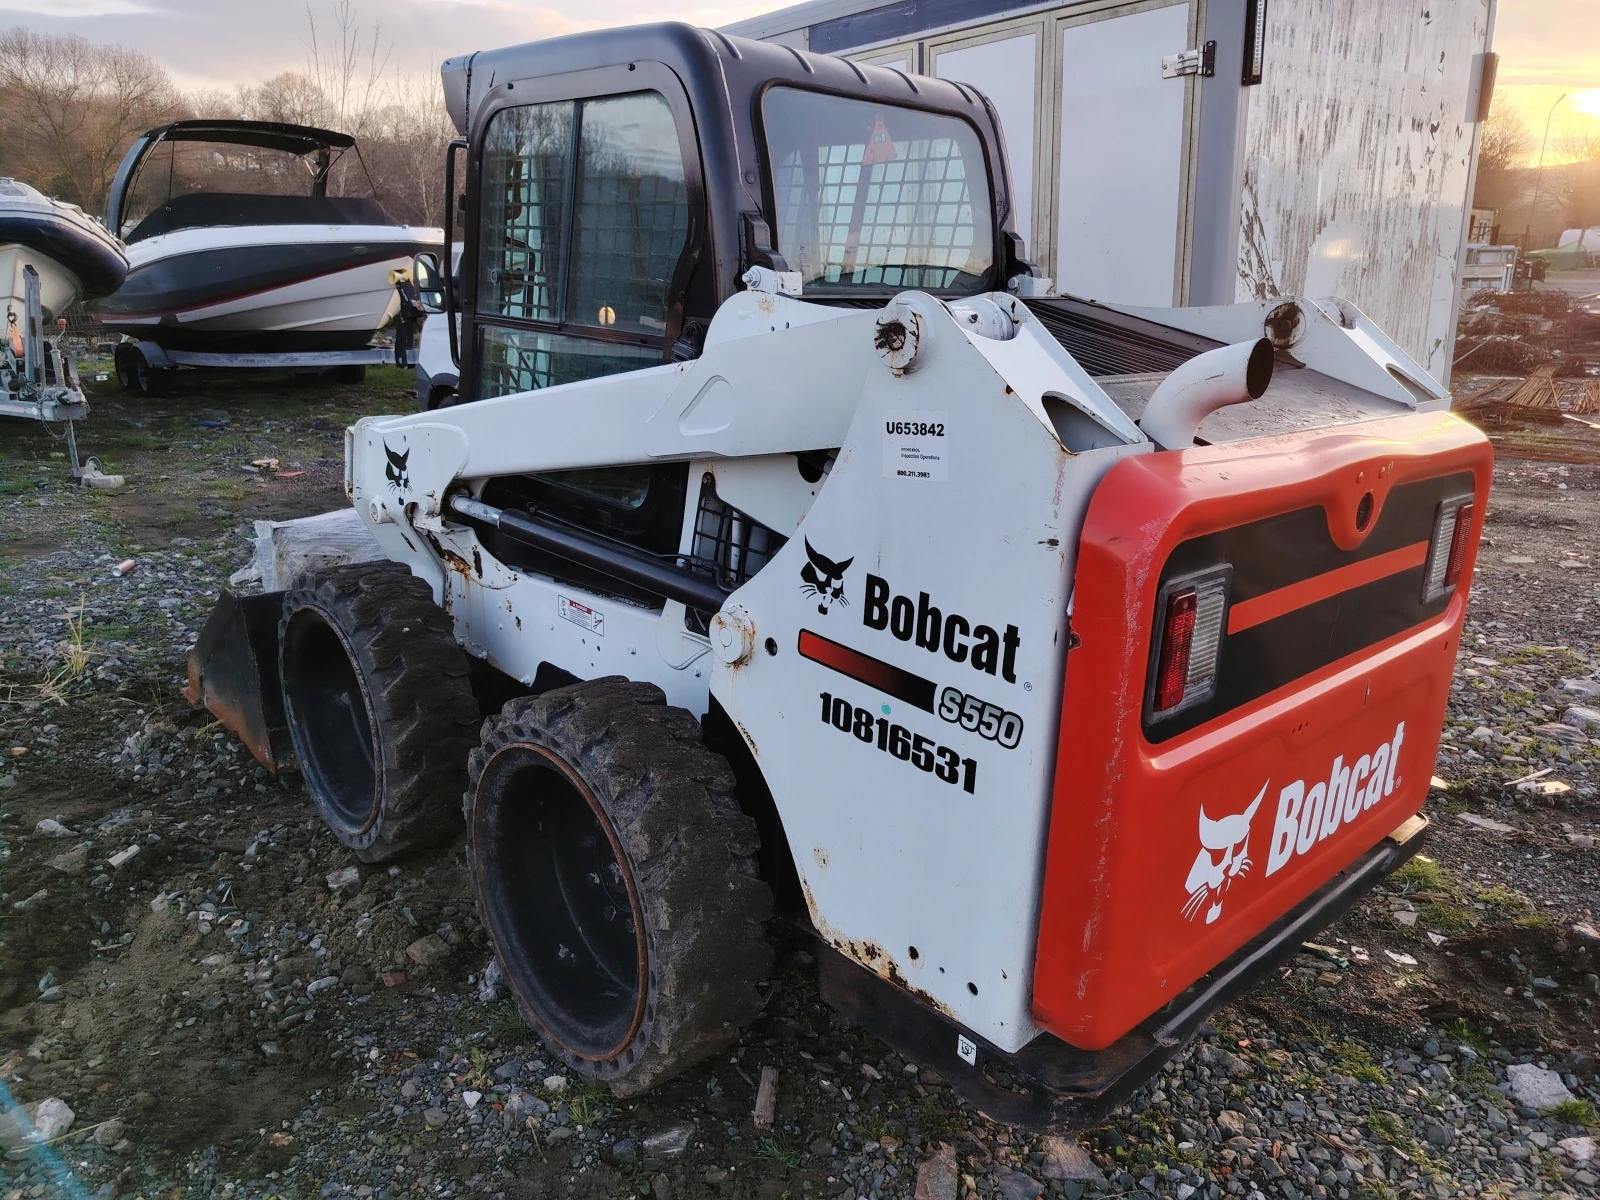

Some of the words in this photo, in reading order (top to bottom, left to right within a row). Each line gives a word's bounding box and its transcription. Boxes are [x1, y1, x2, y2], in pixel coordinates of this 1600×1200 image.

[886, 421, 945, 437] U653842
[863, 573, 1021, 684] Bobcat
[819, 691, 978, 795] 10816531
[938, 686, 1024, 750] S550
[1265, 720, 1405, 878] Bobcat
